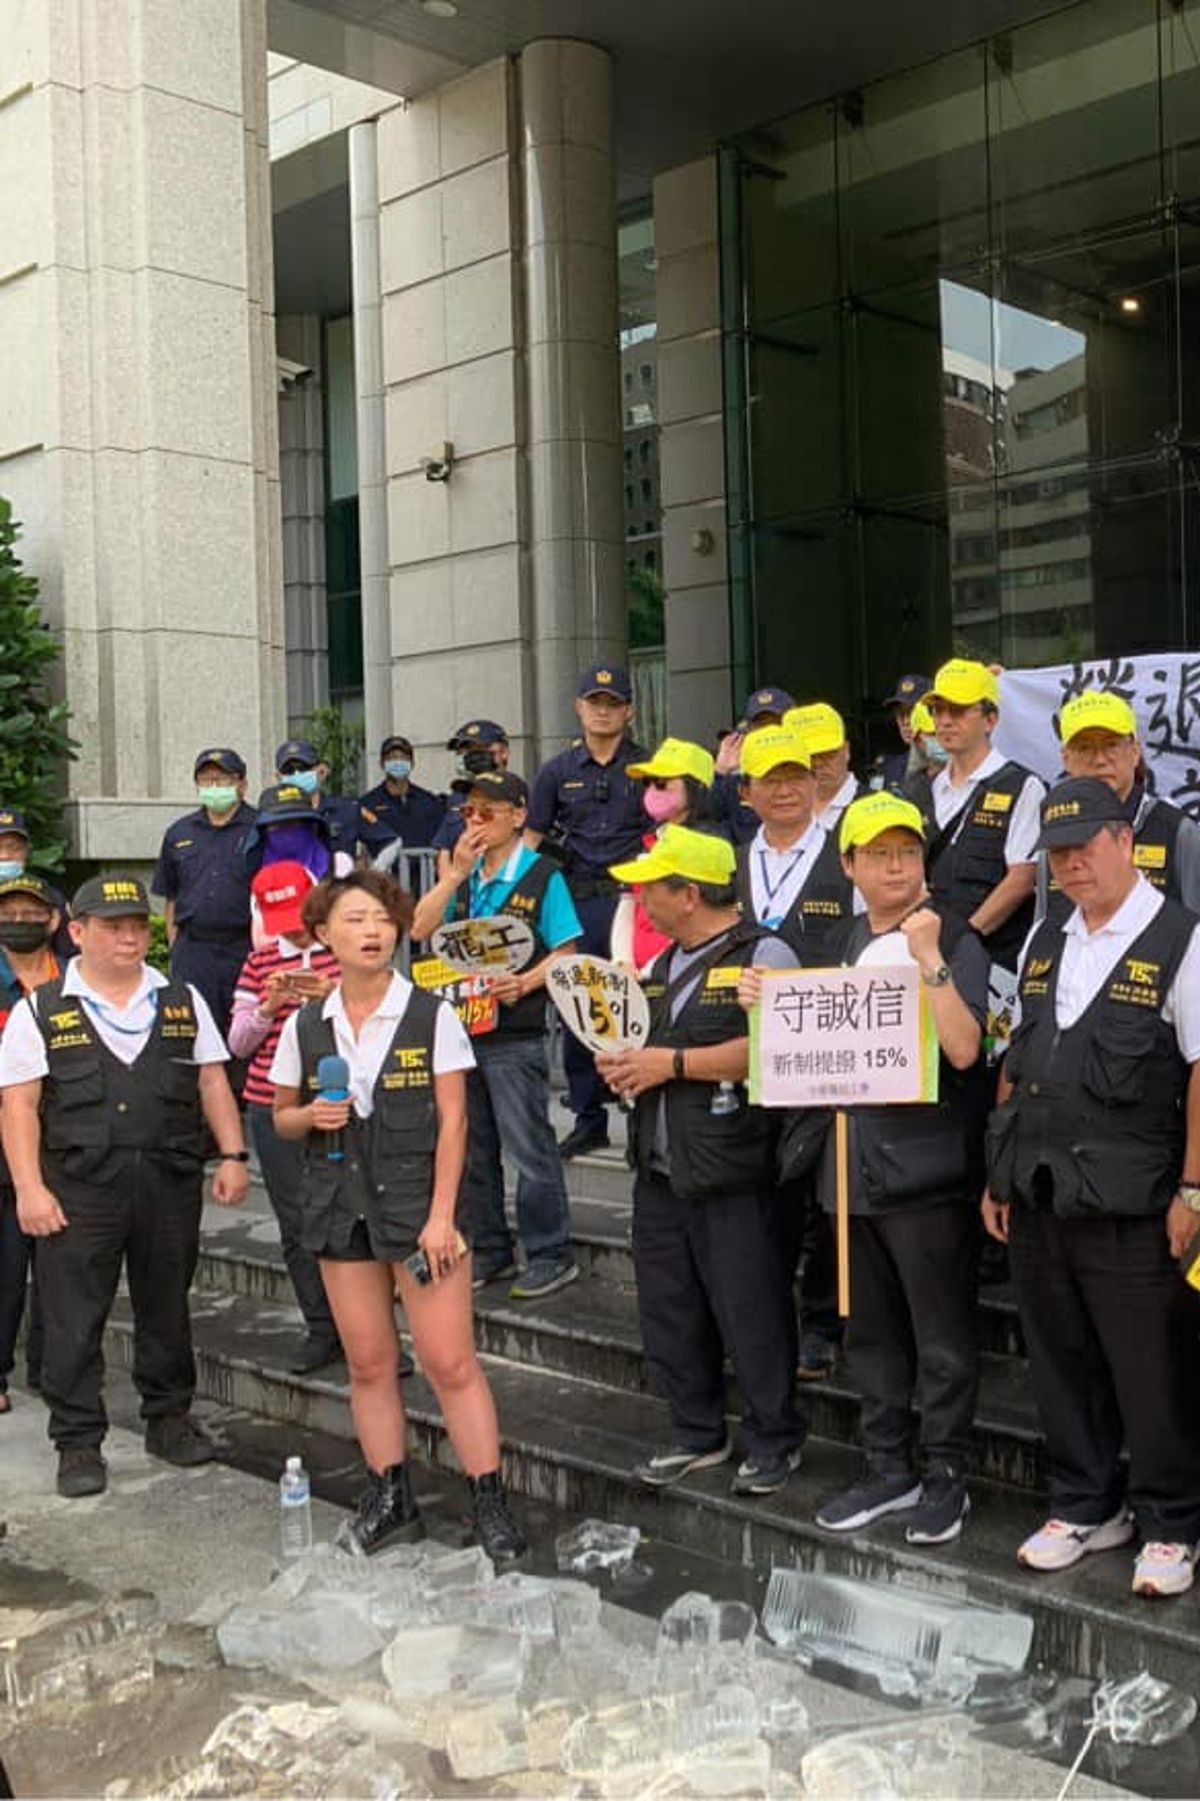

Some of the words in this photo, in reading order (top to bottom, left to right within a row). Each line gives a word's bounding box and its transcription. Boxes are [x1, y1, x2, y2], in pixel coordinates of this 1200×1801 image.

[573, 993, 644, 1039] 15%
[773, 979, 907, 1034] 守誠信
[772, 1050, 856, 1077] 新制提撥
[864, 1047, 908, 1069] 15%
